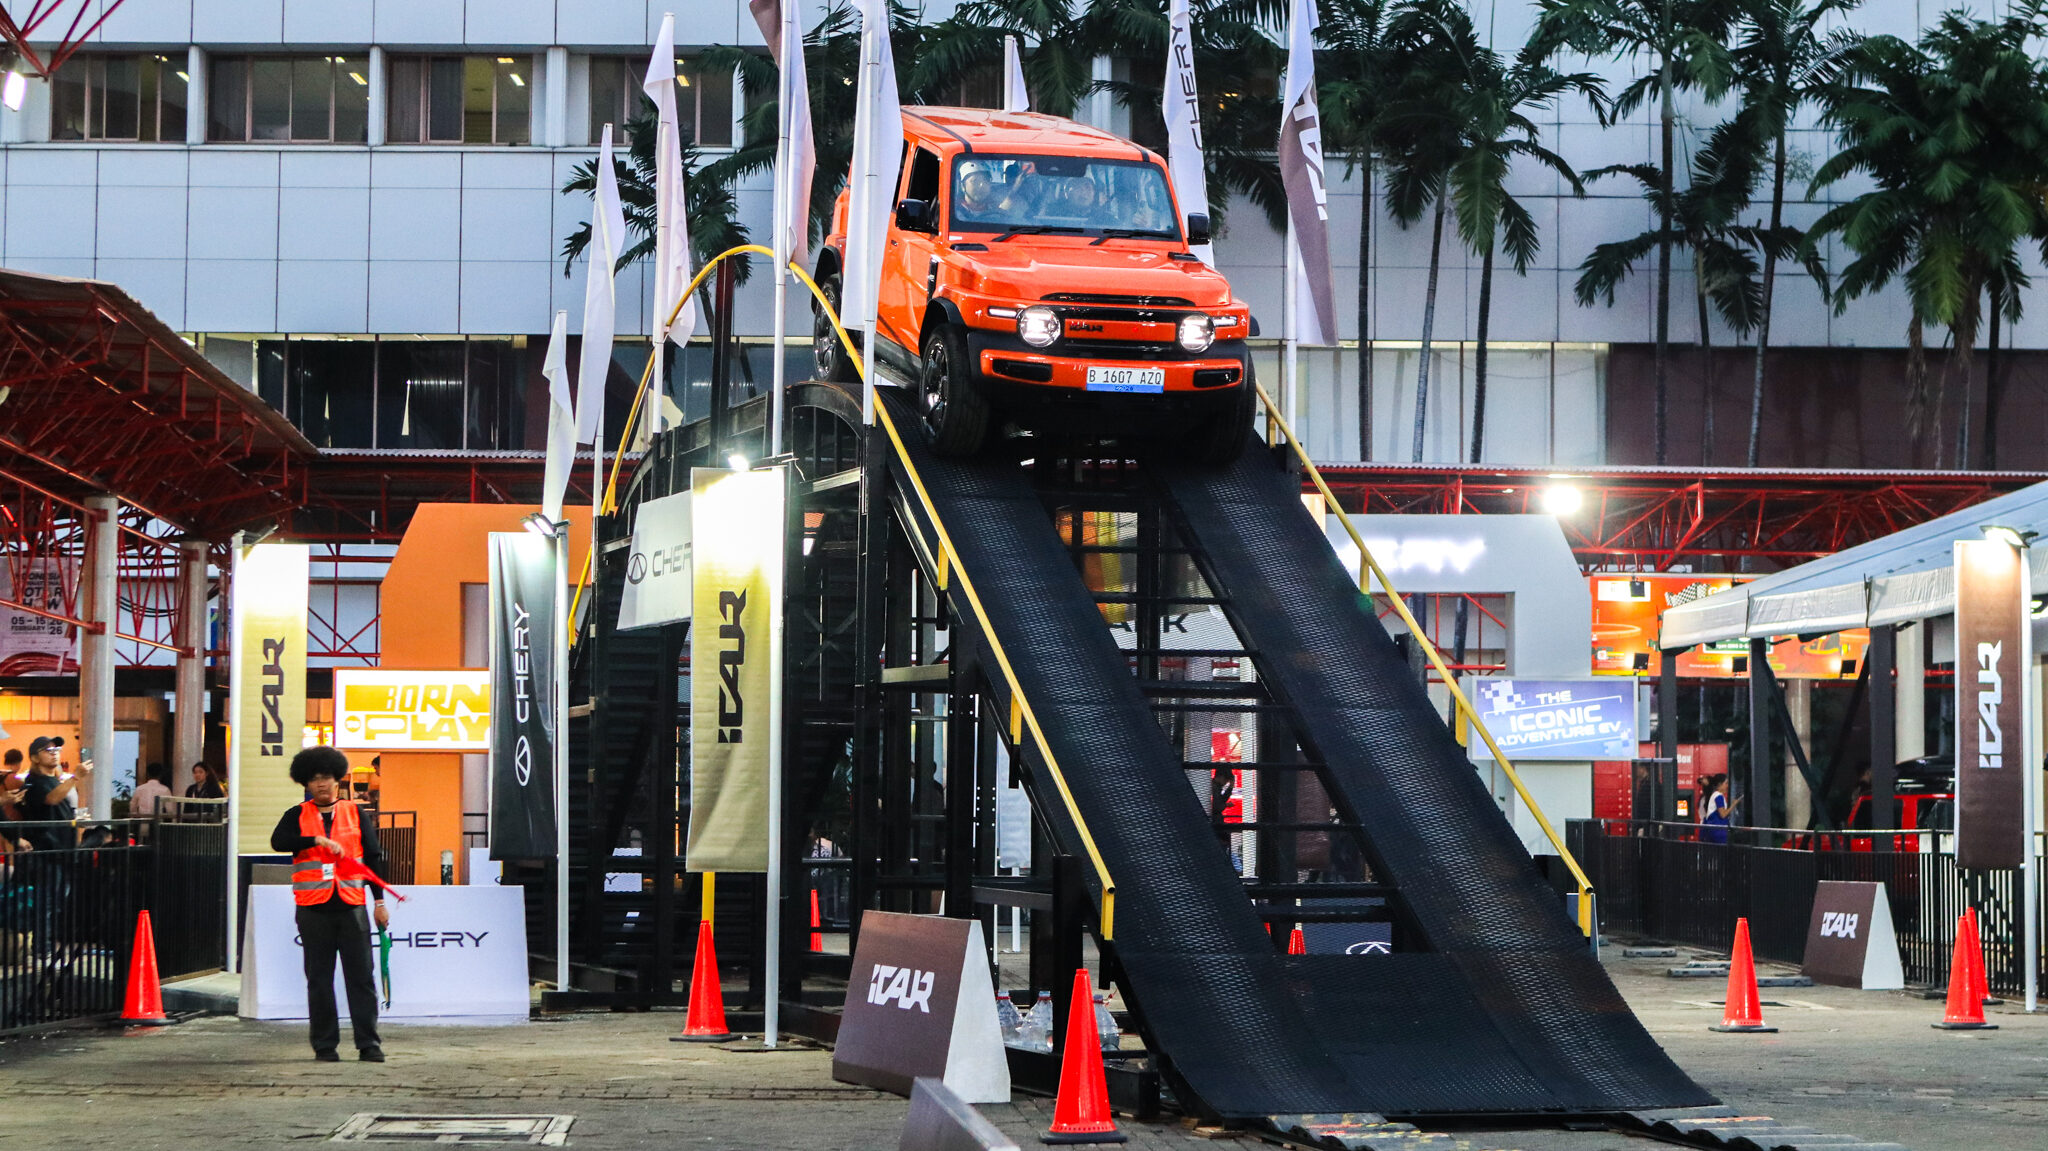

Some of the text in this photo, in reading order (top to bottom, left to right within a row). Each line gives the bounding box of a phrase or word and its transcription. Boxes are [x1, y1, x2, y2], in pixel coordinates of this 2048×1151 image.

[1089, 369, 1162, 385] B 1607 AZQ
[11, 616, 25, 625] 05
[514, 602, 531, 724] CHERY
[1535, 690, 1572, 705] THE
[364, 714, 490, 742] PLAY
[1510, 704, 1603, 733] ICONIC
[1495, 721, 1622, 747] ADVENTURE EV
